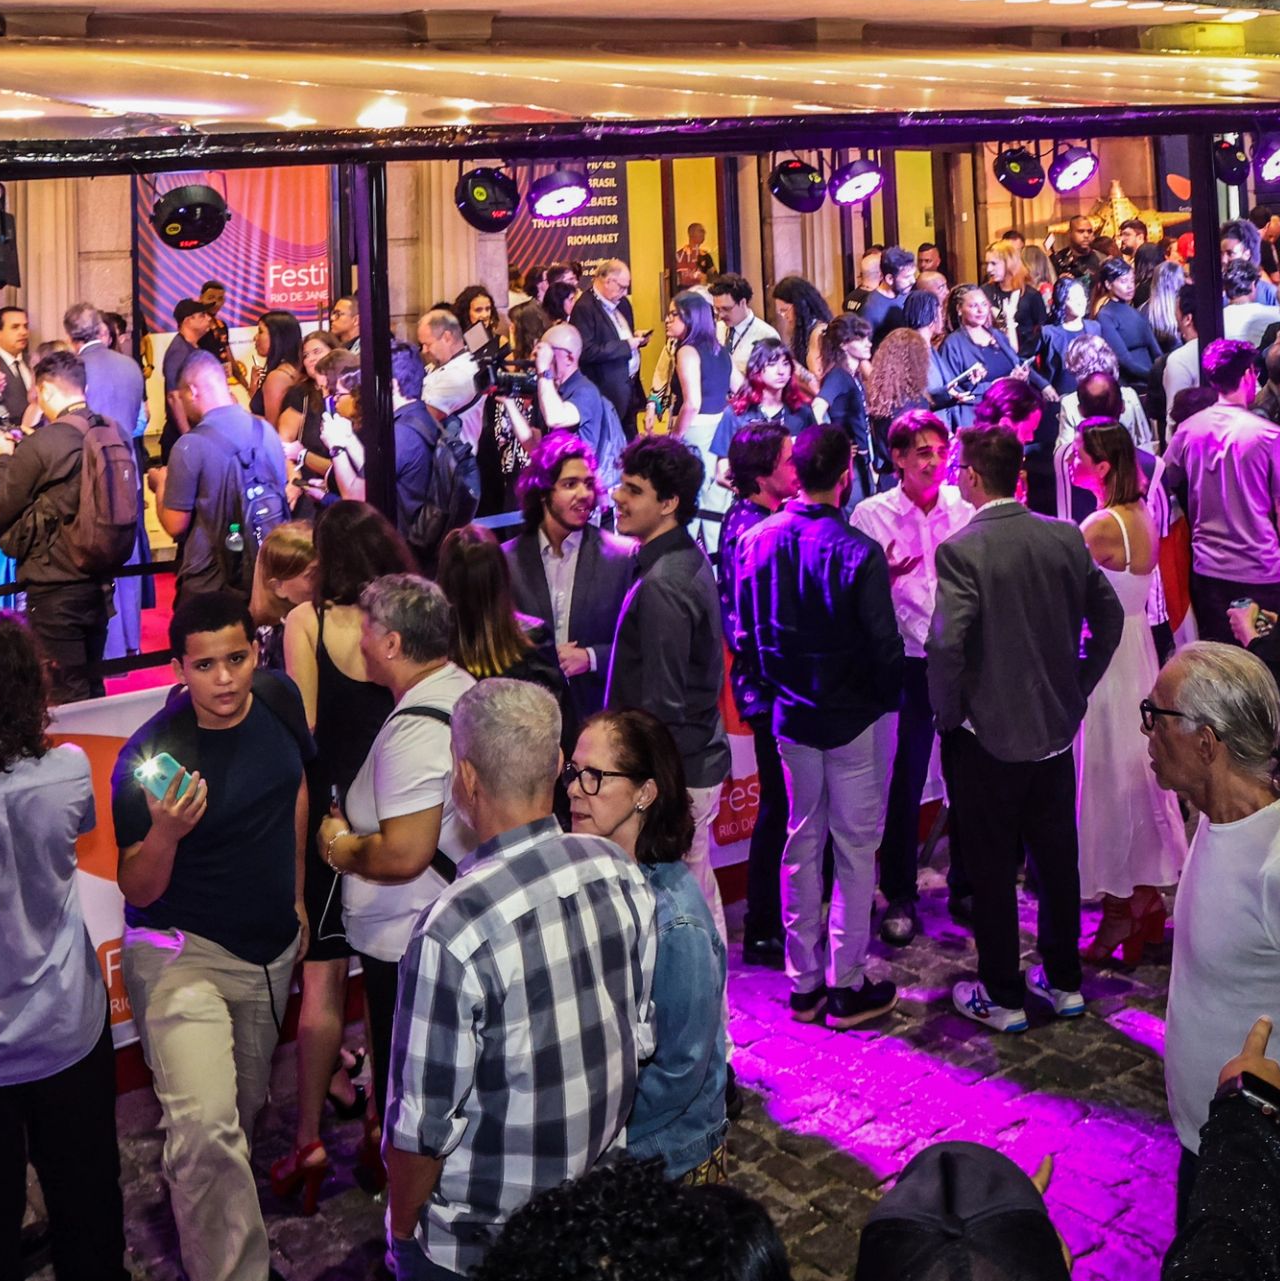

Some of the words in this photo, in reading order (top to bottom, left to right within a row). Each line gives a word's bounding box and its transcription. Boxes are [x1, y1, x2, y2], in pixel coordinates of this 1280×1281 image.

[571, 215, 618, 227] REDENTOR
[567, 233, 619, 246] RIOMARKET
[270, 293, 289, 303] RIO
[290, 291, 303, 302] DE
